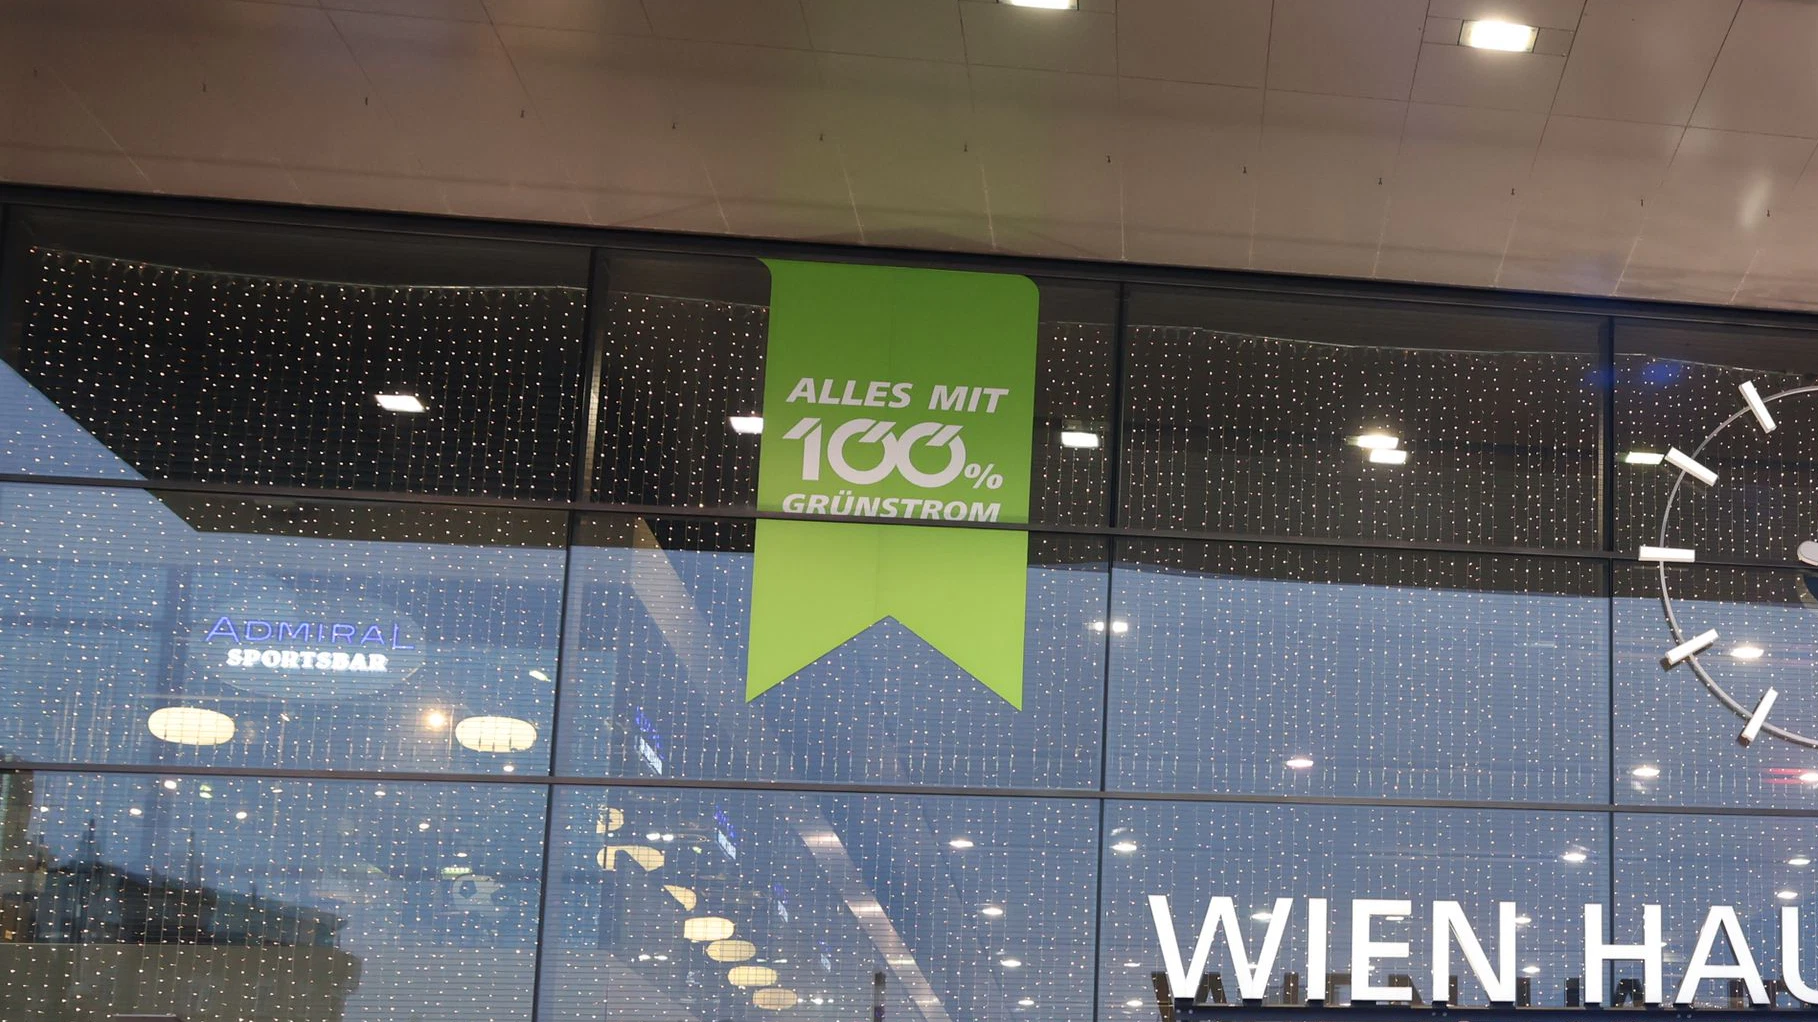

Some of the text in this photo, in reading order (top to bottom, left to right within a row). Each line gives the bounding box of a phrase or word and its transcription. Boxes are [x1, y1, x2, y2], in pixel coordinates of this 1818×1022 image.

[786, 376, 1009, 413] ALLES MIT
[782, 417, 1003, 490] 100%
[782, 490, 1000, 522] GRÜNSTROM
[206, 615, 414, 650] ADMIRAL
[226, 647, 387, 672] SPORTSBAR
[1147, 895, 1517, 1003] WIEN
